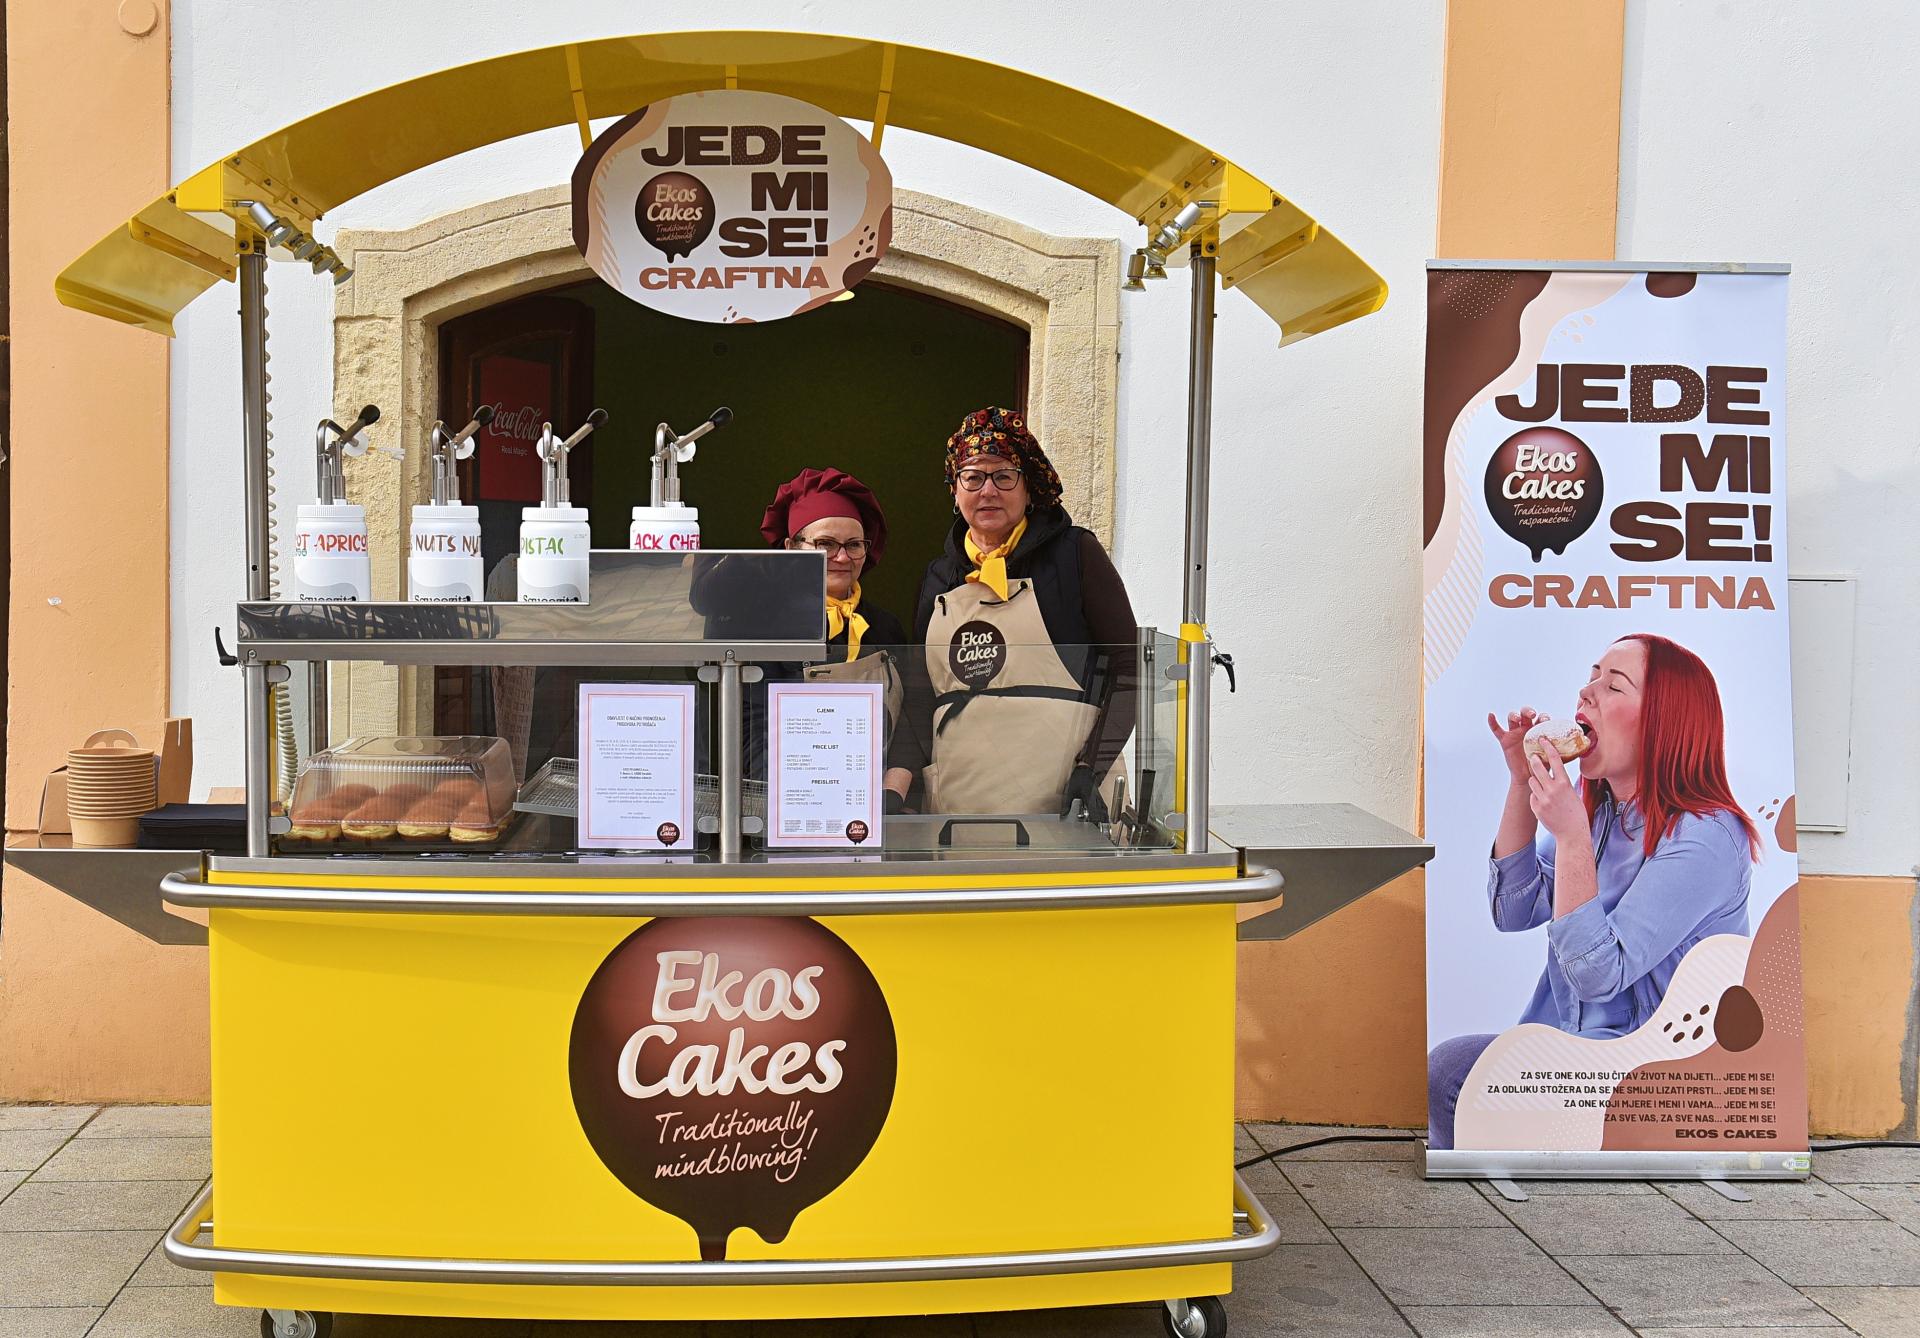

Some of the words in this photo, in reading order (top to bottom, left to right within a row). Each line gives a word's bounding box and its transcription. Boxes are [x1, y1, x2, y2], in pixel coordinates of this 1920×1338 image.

[640, 125, 828, 167] JEDE
[654, 183, 698, 203] Ekos
[751, 171, 829, 212] MI
[646, 202, 703, 222] Cakes
[718, 217, 829, 258] SE!
[638, 266, 830, 290] CRAFTNA
[1495, 363, 1770, 425] JEDE
[1515, 445, 1578, 472] Ekos
[1660, 434, 1771, 494] MI
[1502, 472, 1586, 500] Cakes
[416, 534, 456, 552] NUTS
[1609, 501, 1773, 563] SE!
[1488, 574, 1775, 611] CRAFTNA
[961, 632, 993, 648] Ekos
[956, 645, 998, 663] Cakes
[652, 950, 824, 1022] Ekos
[618, 1024, 847, 1099] Cakes
[1520, 1072, 1532, 1080] ZA
[1535, 1072, 1552, 1080] SVE
[1554, 1072, 1572, 1080] ONE
[1574, 1072, 1596, 1080] KOJI
[1597, 1072, 1610, 1080] SU
[1612, 1070, 1638, 1080] ČITAV
[1640, 1071, 1666, 1080] ŽIVOT
[1668, 1072, 1680, 1080] NA
[1684, 1072, 1721, 1081] DIJETI...
[1723, 1073, 1746, 1081] JEDE
[1748, 1073, 1758, 1081] MI
[1760, 1073, 1775, 1081] SE!
[1488, 1086, 1500, 1094] ZA
[1502, 1086, 1538, 1094] ODLUKU
[1540, 1084, 1582, 1094] STOŽERA
[1584, 1086, 1596, 1094] DA
[1599, 1086, 1611, 1094] SE
[1613, 1086, 1625, 1094] NE
[1627, 1086, 1654, 1094] SMIJU
[1656, 1086, 1684, 1094] LIZATI
[1687, 1086, 1722, 1095] PRSTI...
[1724, 1087, 1746, 1095] JEDE
[1749, 1087, 1758, 1095] MI
[1760, 1087, 1775, 1095] SE!
[1564, 1099, 1576, 1108] ZA
[1578, 1100, 1597, 1108] ONE
[1599, 1100, 1620, 1108] KOJI
[1622, 1100, 1652, 1108] MJERE
[1654, 1100, 1656, 1108] I
[1658, 1100, 1680, 1108] MENI
[1683, 1100, 1685, 1108] I
[1688, 1100, 1722, 1109] VAMA...
[1724, 1101, 1747, 1109] JEDE
[1749, 1101, 1759, 1109] MI
[1761, 1101, 1776, 1109] SE!
[656, 1100, 814, 1150] Traditionally
[1604, 1114, 1617, 1122] ZA
[1619, 1114, 1636, 1122] SVE
[1639, 1114, 1658, 1123] VAS,
[1661, 1114, 1673, 1122] ZA
[1675, 1114, 1693, 1122] SVE
[1695, 1114, 1722, 1123] NAS...
[1724, 1115, 1748, 1123] JEDE
[1750, 1115, 1759, 1123] MI
[1761, 1115, 1776, 1123] SE!
[1676, 1129, 1718, 1138] EKOS
[1724, 1129, 1777, 1139] CAKES
[655, 1128, 818, 1182] mindblowing!
